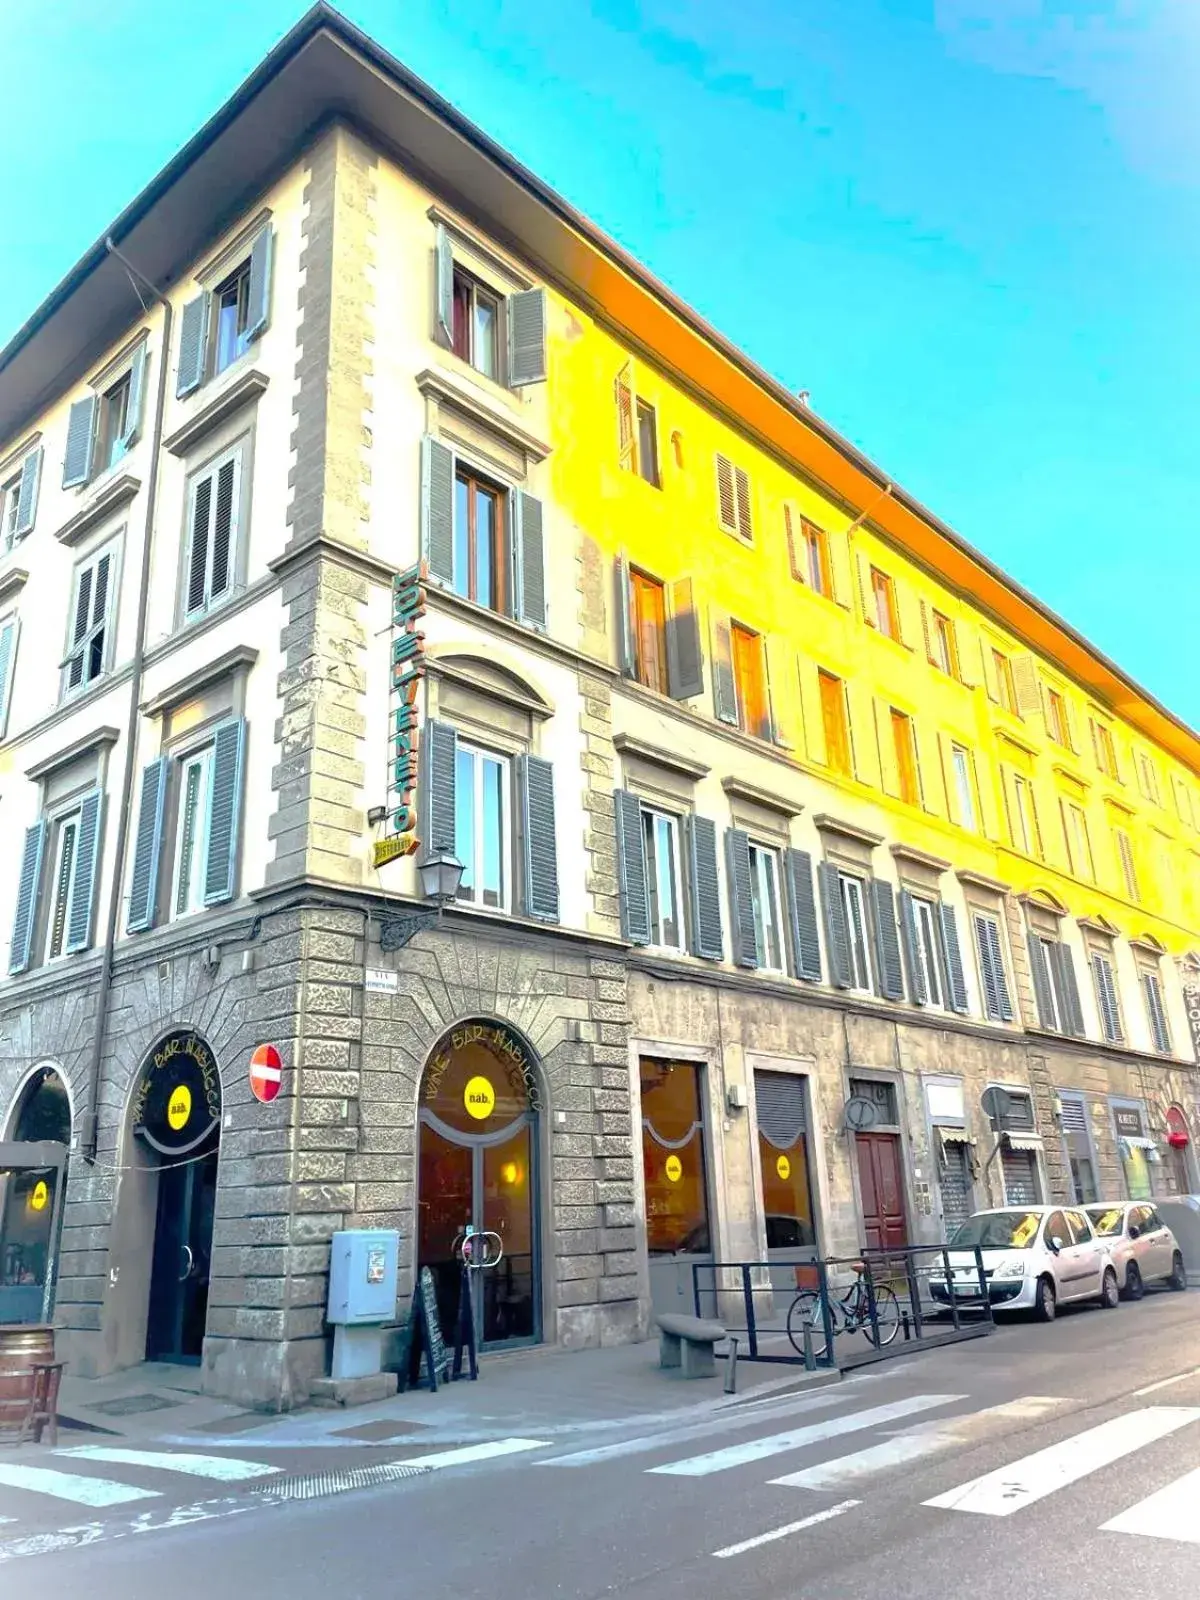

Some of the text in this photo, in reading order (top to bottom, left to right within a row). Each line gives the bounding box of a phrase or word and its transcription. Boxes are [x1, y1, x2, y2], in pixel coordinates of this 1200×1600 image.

[392, 557, 428, 832] HOTEL VENETO
[154, 1040, 181, 1068] BAR
[425, 1026, 545, 1110] WINE BAR NABUCCO
